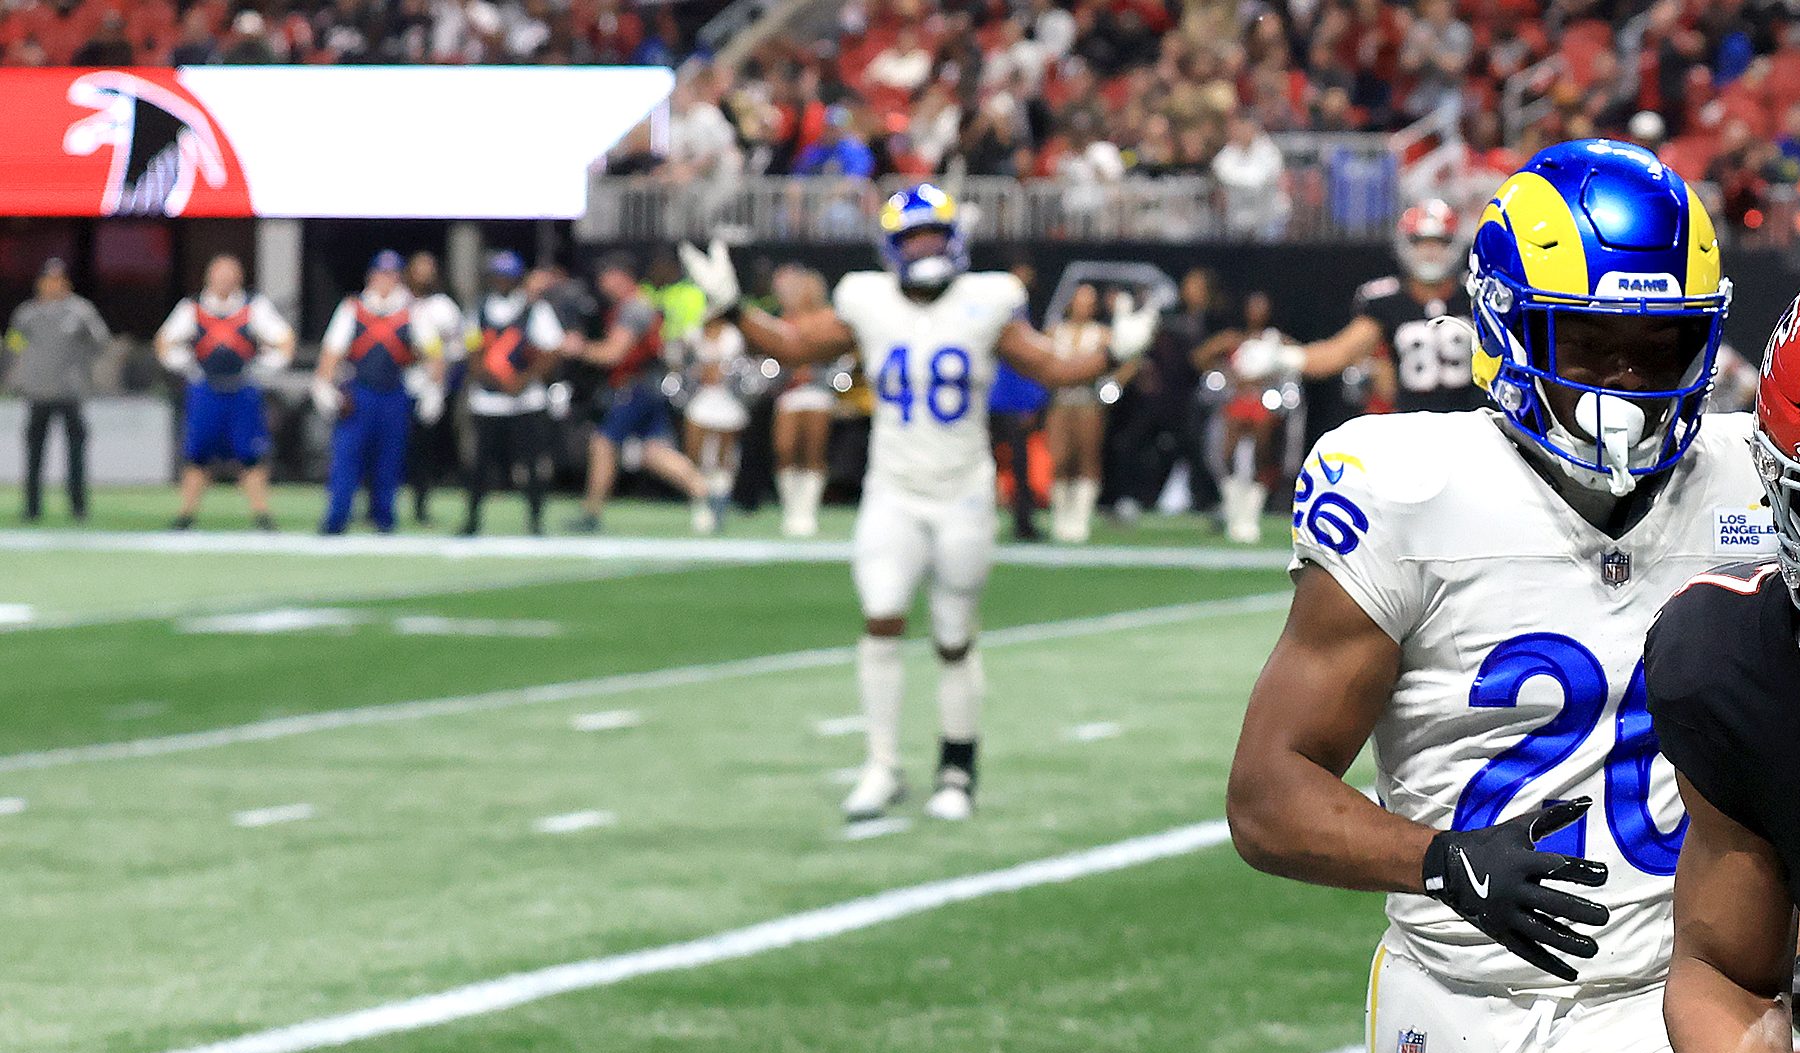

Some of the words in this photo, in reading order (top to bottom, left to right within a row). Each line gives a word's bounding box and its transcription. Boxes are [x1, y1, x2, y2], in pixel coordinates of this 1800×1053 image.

[1618, 278, 1669, 292] RAMS
[1394, 317, 1472, 392] 89
[879, 343, 970, 424] 48
[1719, 514, 1747, 525] LOS
[1720, 525, 1776, 535] ANGELE
[1720, 535, 1760, 545] RAMS
